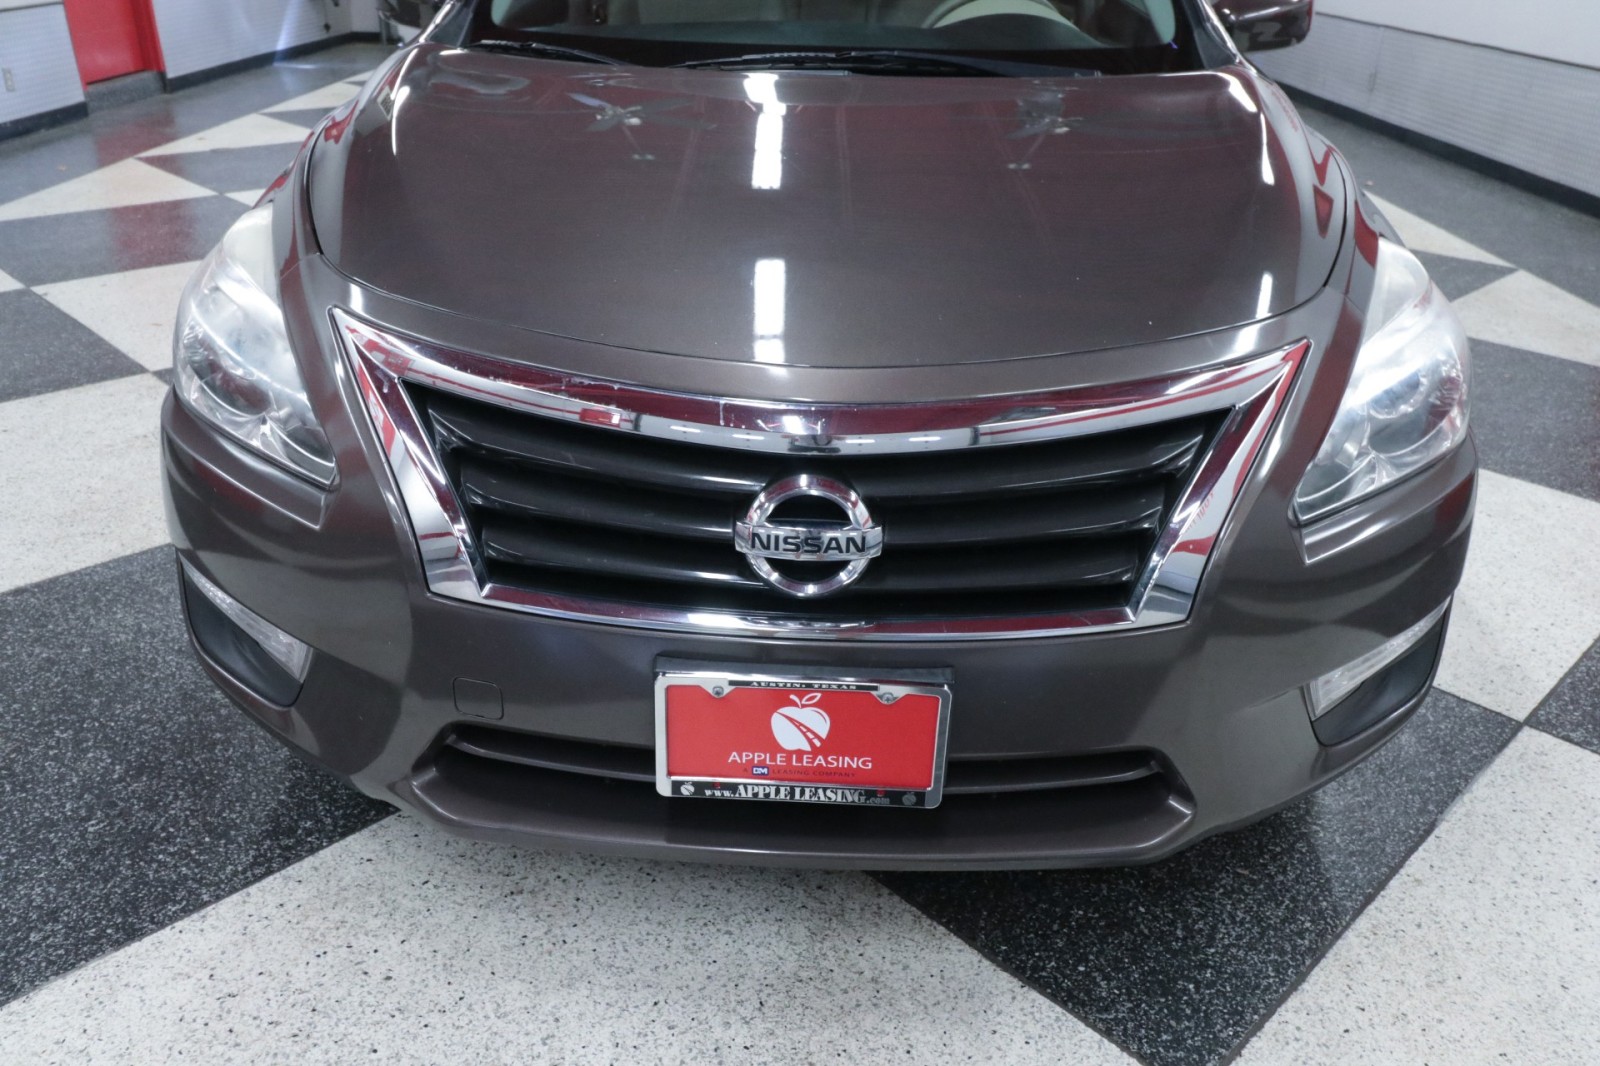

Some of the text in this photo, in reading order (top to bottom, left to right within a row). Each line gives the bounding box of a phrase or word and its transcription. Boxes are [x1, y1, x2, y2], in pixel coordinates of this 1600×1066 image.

[751, 533, 866, 554] NISSAN
[728, 752, 873, 769] APPLE LEASING
